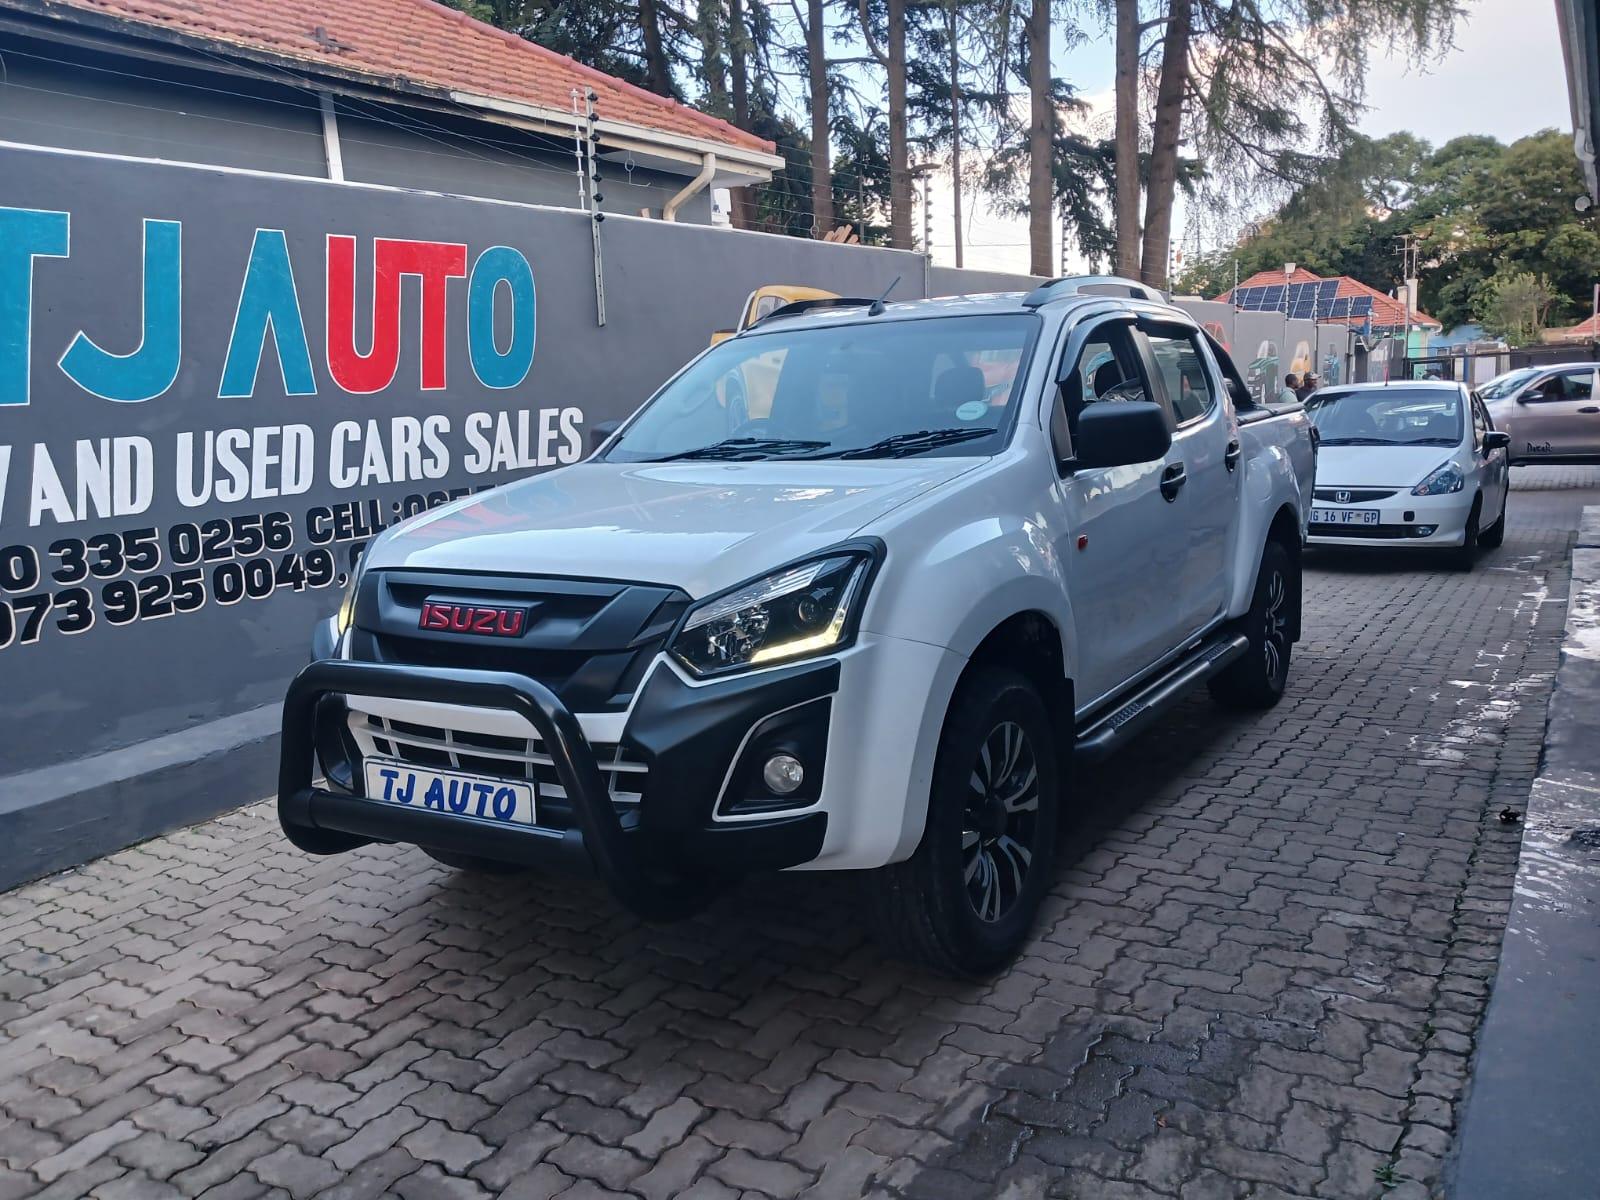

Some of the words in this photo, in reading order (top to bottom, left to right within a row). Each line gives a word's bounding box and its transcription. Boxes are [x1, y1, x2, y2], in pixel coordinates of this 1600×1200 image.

[0, 206, 182, 405] TJ
[217, 228, 537, 398] AUTO
[29, 435, 154, 527] AND
[176, 424, 314, 507] USED
[329, 415, 450, 486] CARS
[464, 407, 583, 474] SALES
[48, 527, 161, 587] 335
[168, 511, 294, 566] 0256
[1324, 511, 1336, 522] 16
[1341, 511, 1354, 522] VF
[1363, 512, 1377, 523] GP
[102, 570, 205, 627] 925
[213, 549, 349, 606] 0049,
[420, 604, 524, 635] ISUZU
[380, 768, 416, 804] TJ
[424, 777, 517, 821] AUTO
